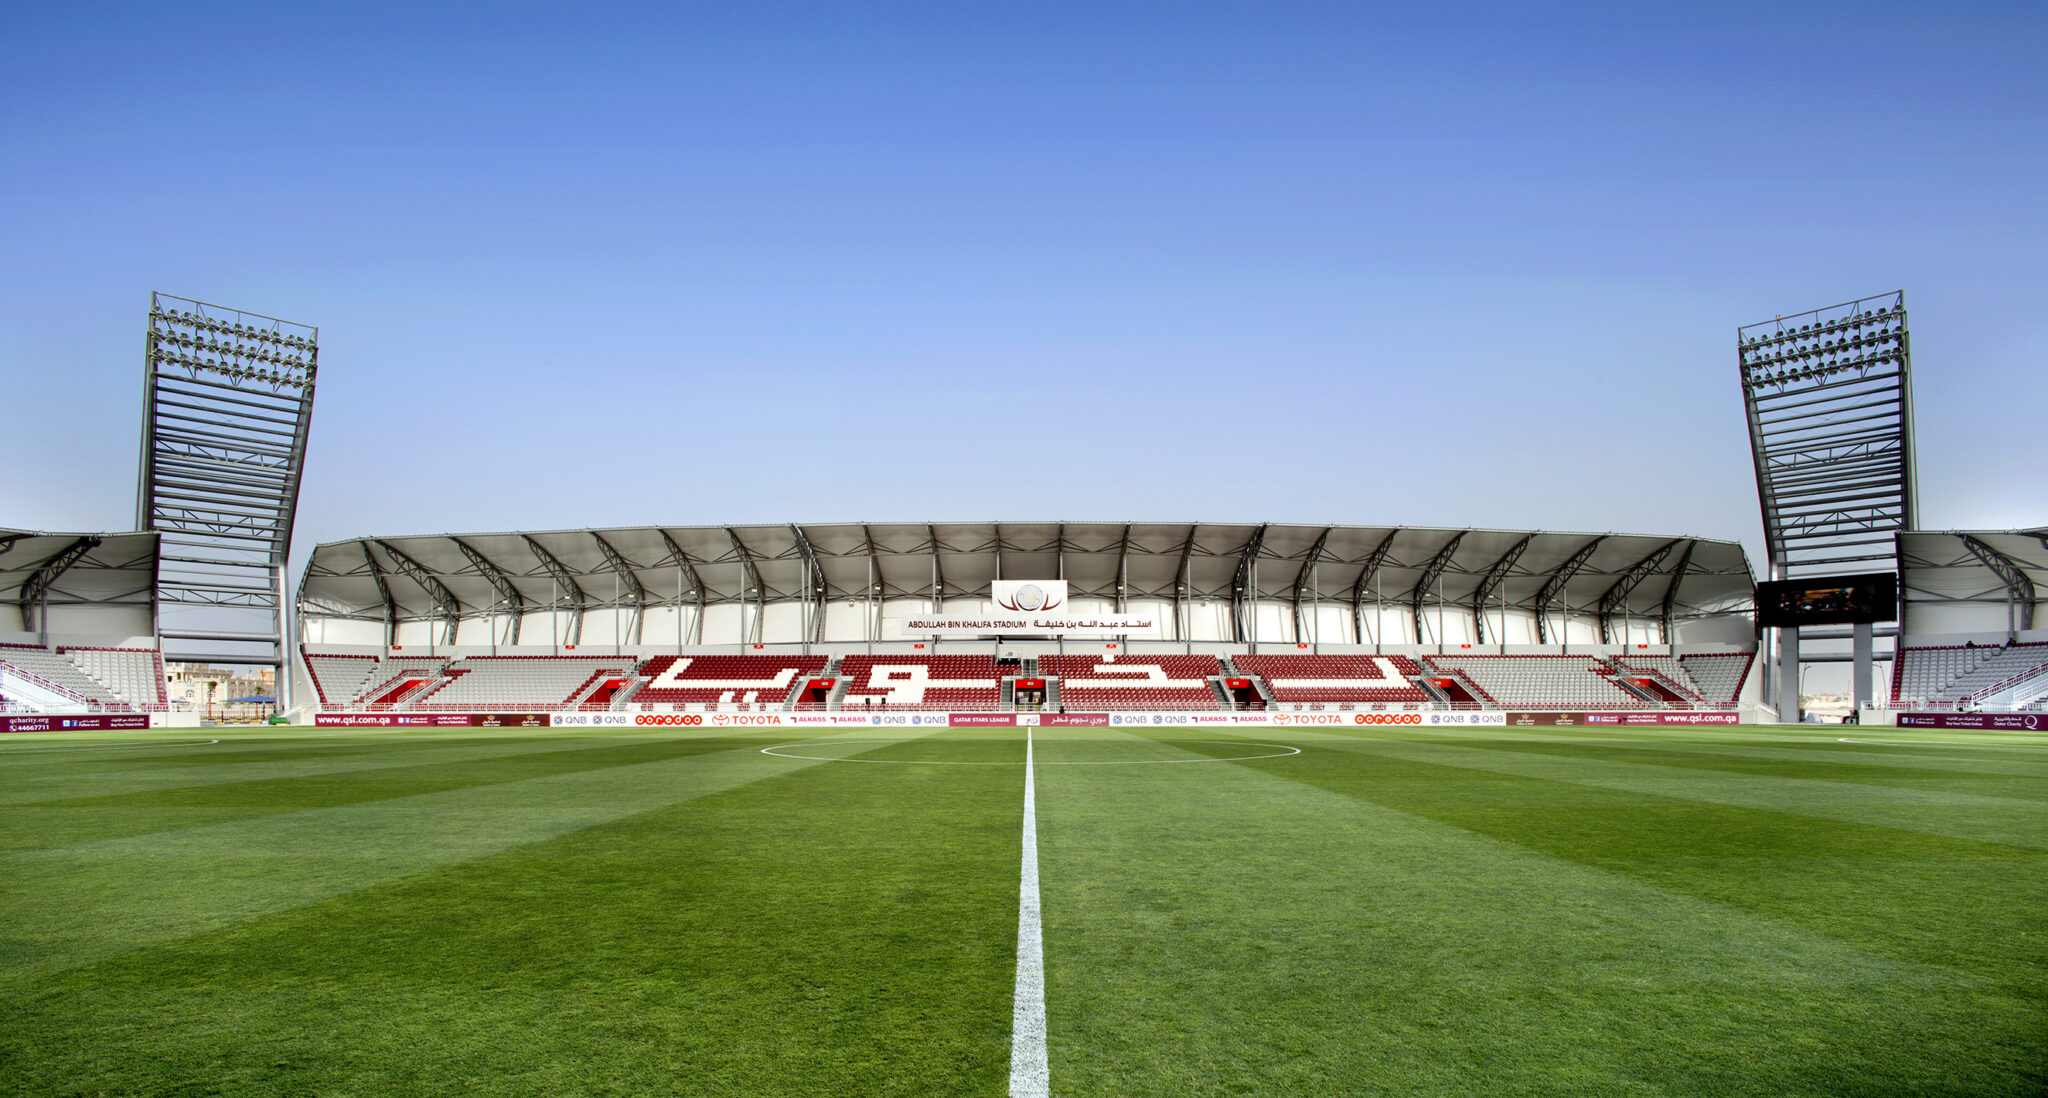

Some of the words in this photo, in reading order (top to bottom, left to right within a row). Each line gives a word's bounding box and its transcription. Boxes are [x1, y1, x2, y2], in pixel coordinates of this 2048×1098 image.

[908, 620, 946, 628] ABDULLAH
[948, 620, 960, 628] BIN
[962, 620, 992, 628] KHALIFA
[993, 620, 1026, 628] STADIUM
[1033, 620, 1064, 629] خليفة
[1066, 620, 1076, 629] بن
[1099, 621, 1118, 629] عبد
[318, 716, 390, 725] www.qsl.com.qa
[565, 716, 587, 724] QNB
[604, 716, 626, 724] QNB
[635, 714, 702, 726] ooredoo
[732, 716, 780, 724] TOYOTA
[1051, 716, 1068, 724] قطر
[1294, 715, 1342, 724] TOYOTA
[1355, 714, 1422, 724] ooredoo
[1664, 715, 1736, 724] www.qsl.com.qa
